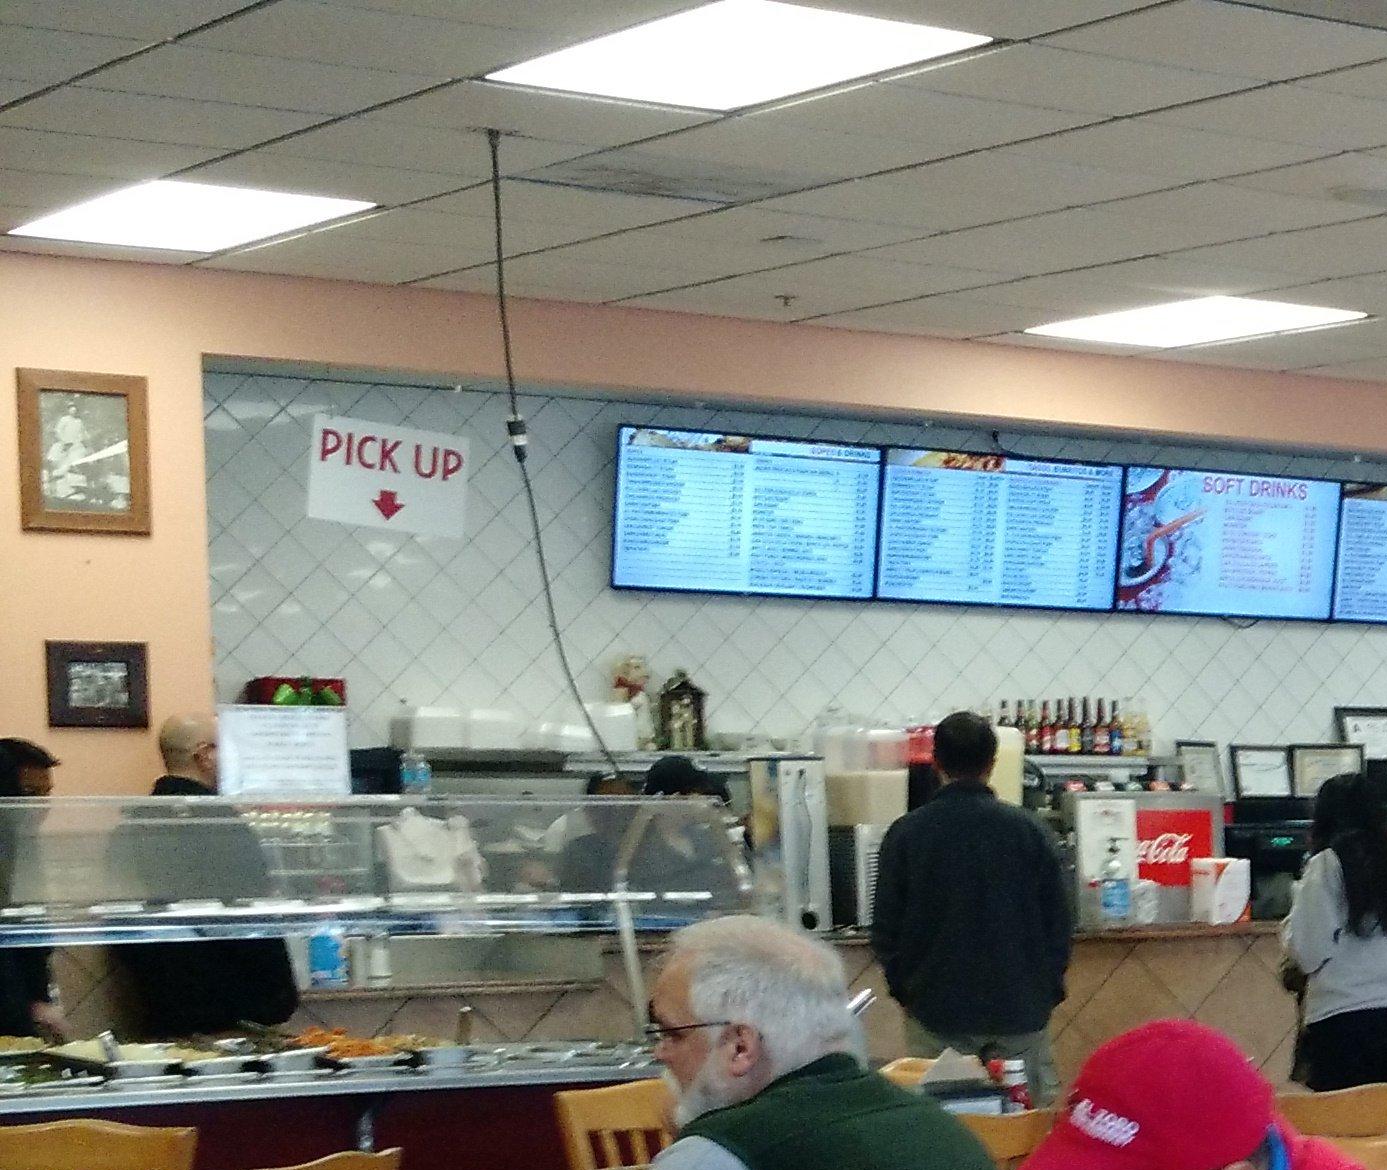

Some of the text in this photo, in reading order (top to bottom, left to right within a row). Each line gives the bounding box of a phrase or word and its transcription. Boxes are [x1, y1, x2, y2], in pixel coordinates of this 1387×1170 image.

[320, 428, 465, 481] PICK UP
[1202, 476, 1309, 501] SOFT DRINKS
